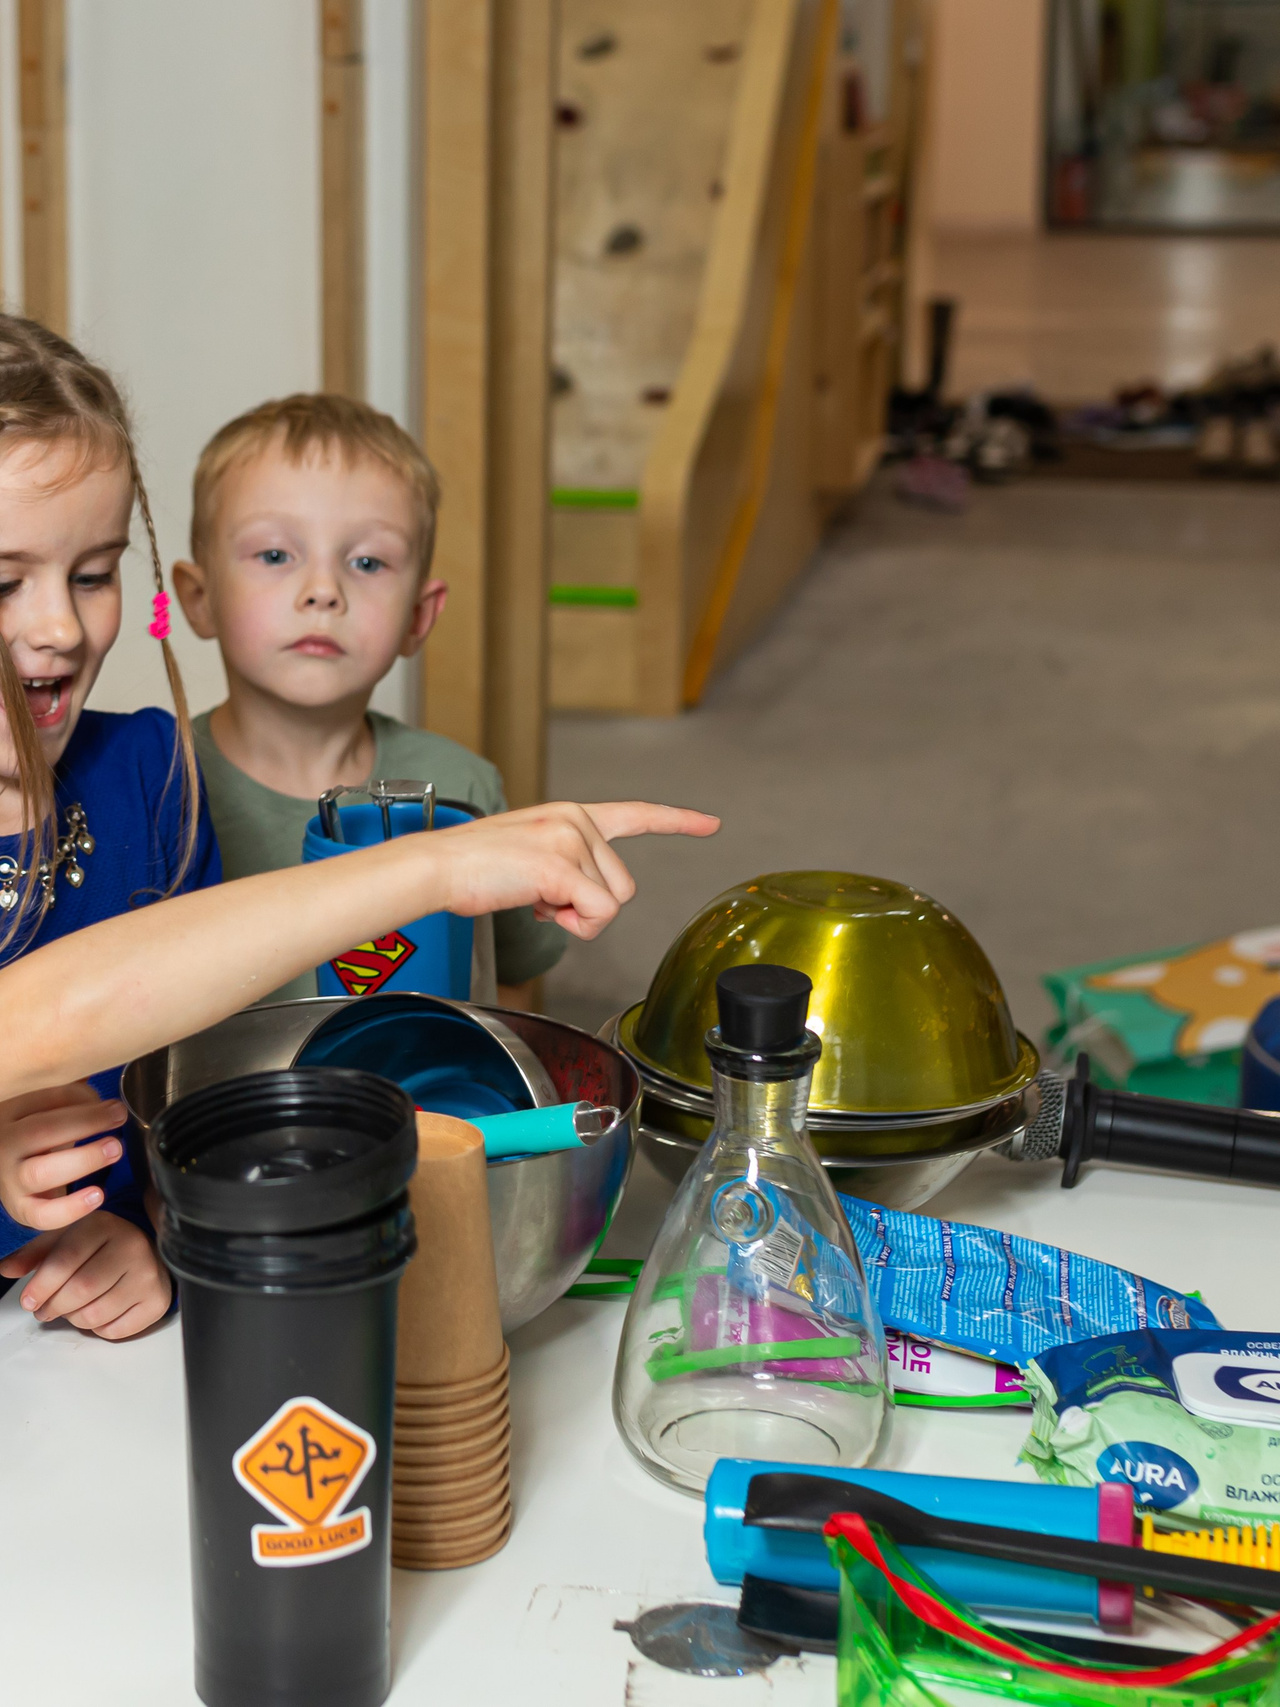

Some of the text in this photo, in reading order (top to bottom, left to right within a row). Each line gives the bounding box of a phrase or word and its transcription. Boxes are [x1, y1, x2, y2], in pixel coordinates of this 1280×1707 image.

[910, 1343, 932, 1374] ОЕ
[1109, 1457, 1187, 1491] AURA
[1226, 1485, 1280, 1503] ВЛАЖ
[266, 1525, 358, 1551] GOOD LUCK
